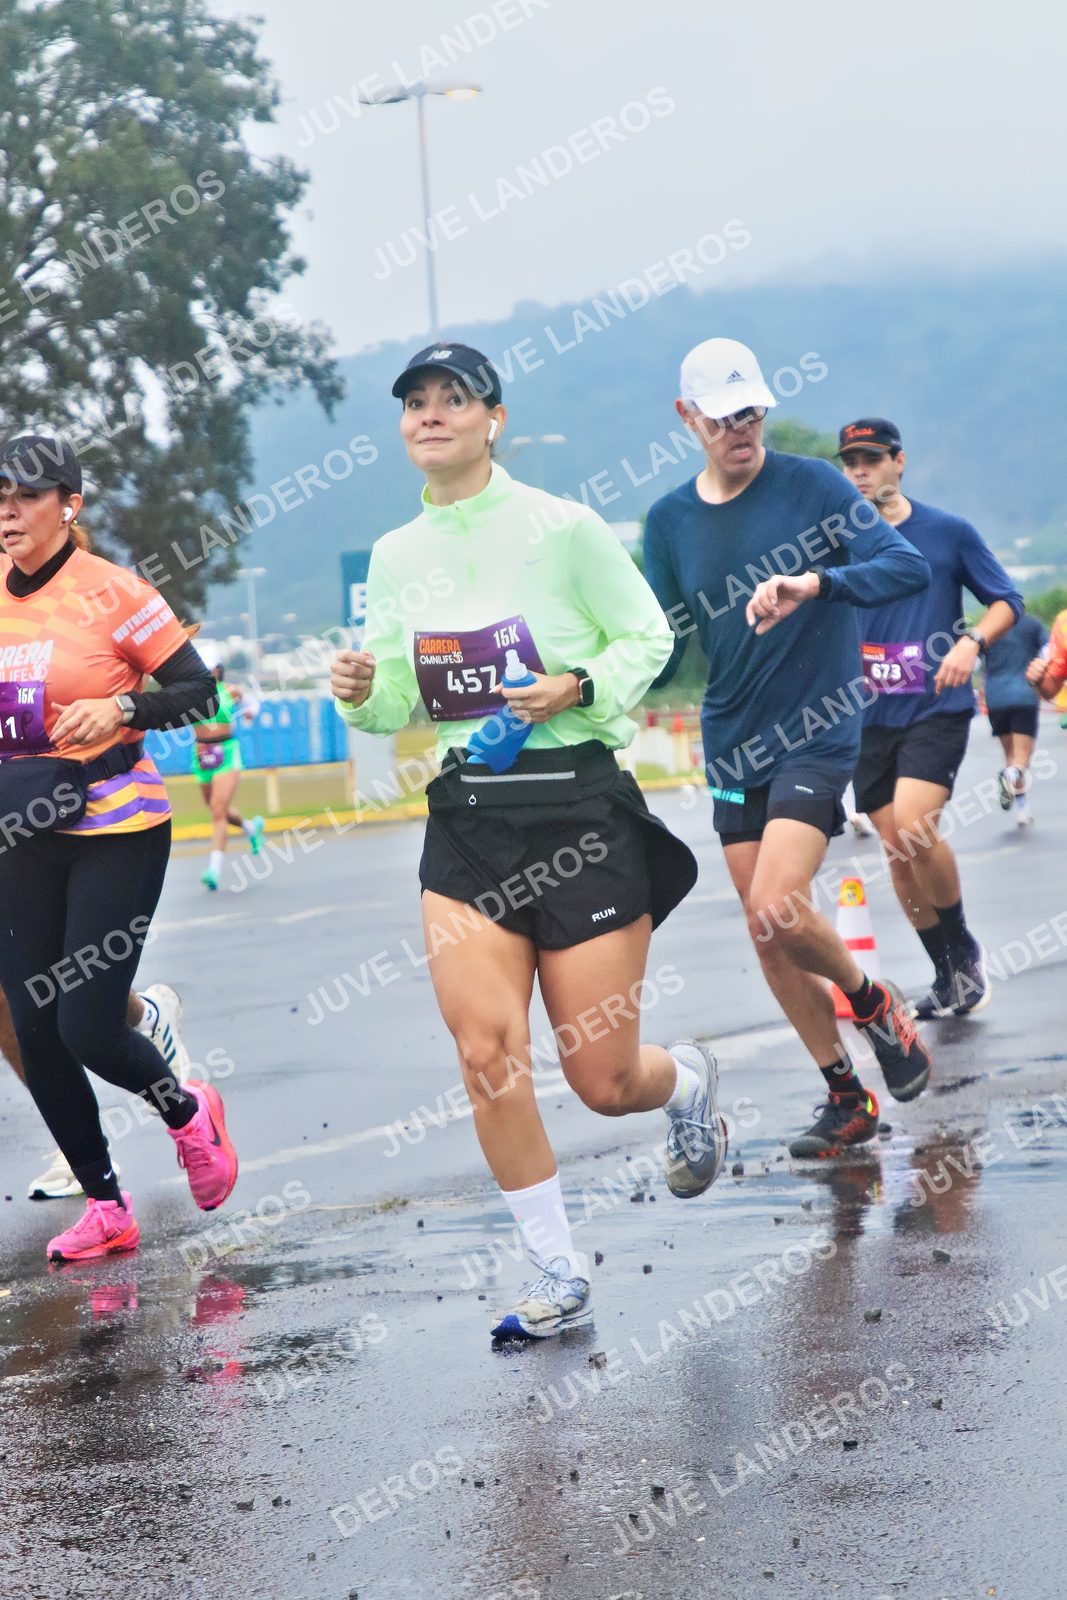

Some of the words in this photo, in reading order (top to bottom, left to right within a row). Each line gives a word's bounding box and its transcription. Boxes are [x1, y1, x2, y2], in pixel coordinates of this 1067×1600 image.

[493, 623, 521, 649] 15K
[419, 639, 461, 654] CARRERA
[447, 664, 498, 694] 457
[17, 687, 36, 704] 15K
[591, 906, 616, 922] RUN
